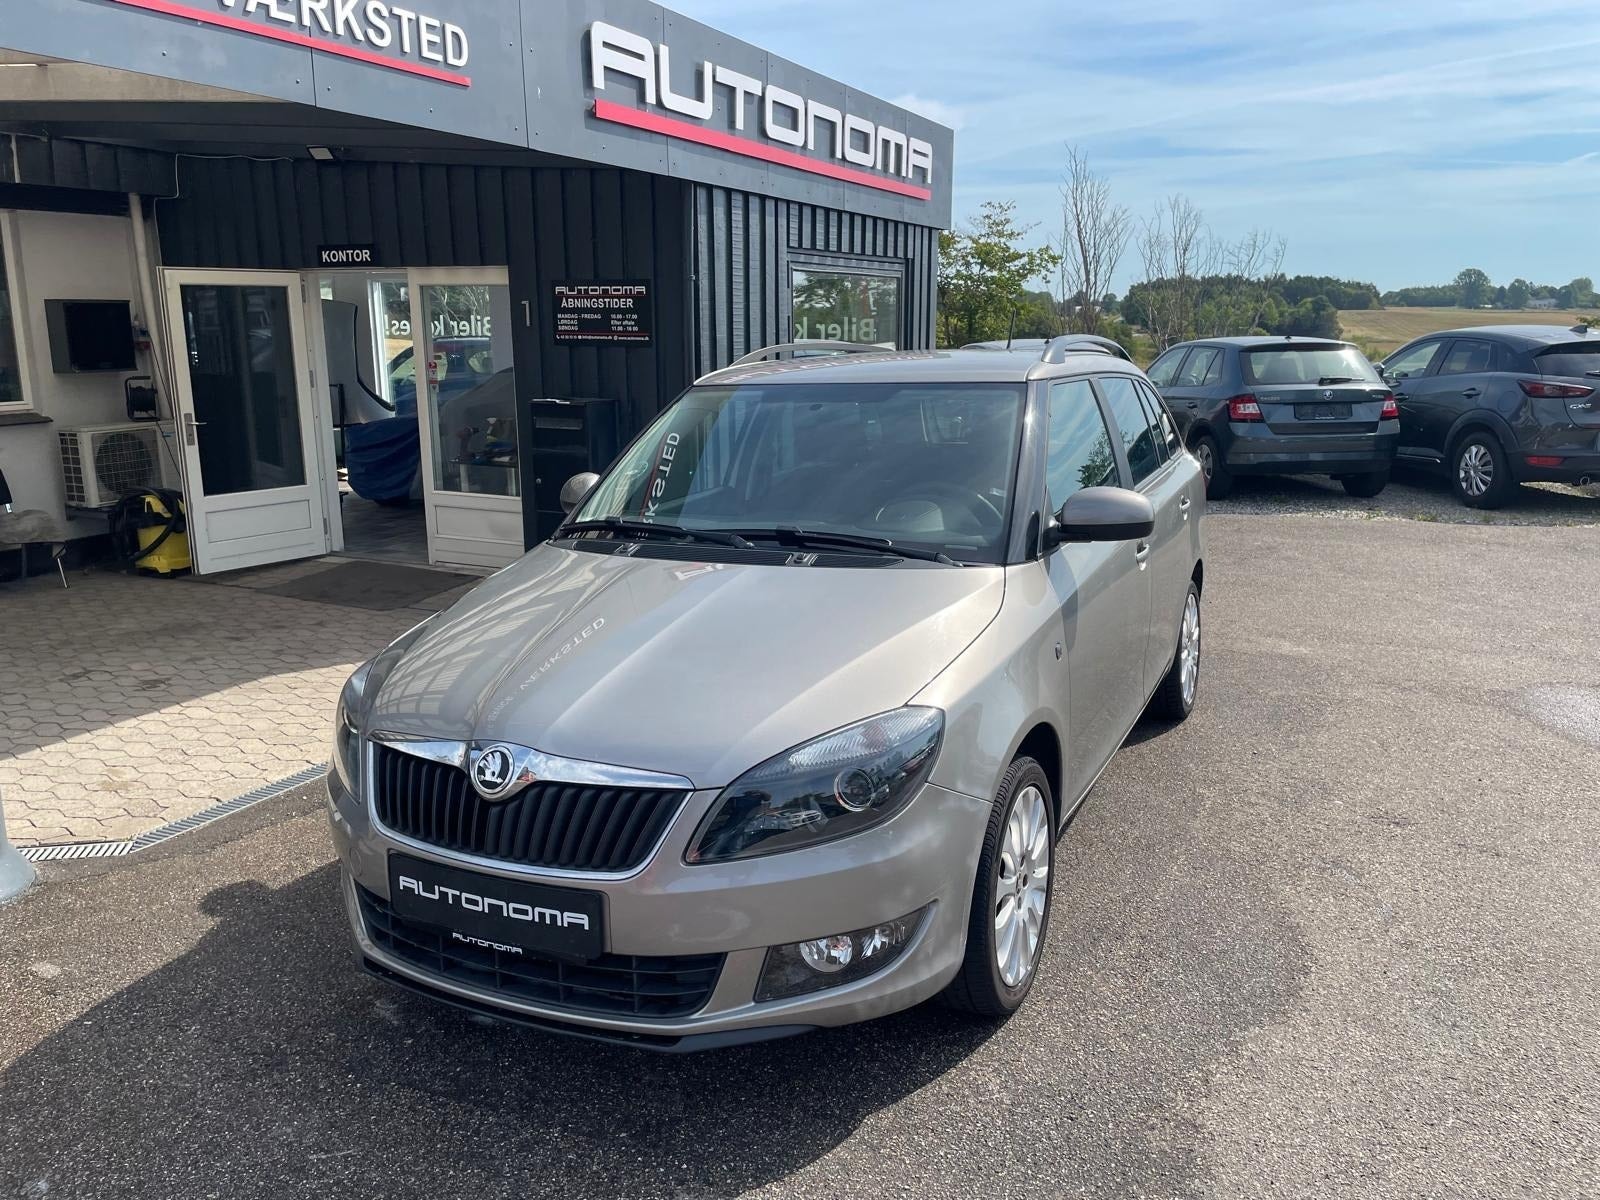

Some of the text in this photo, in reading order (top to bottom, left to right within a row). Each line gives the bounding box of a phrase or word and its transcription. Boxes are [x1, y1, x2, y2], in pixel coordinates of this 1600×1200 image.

[590, 21, 933, 184] AUTONOMA
[321, 249, 371, 262] KONTOR
[555, 286, 646, 295] AUTONOMA
[561, 297, 634, 308] ÅBNINGSTIDER
[399, 875, 589, 930] AUTONOMA
[452, 932, 523, 955] AUTONOMA
